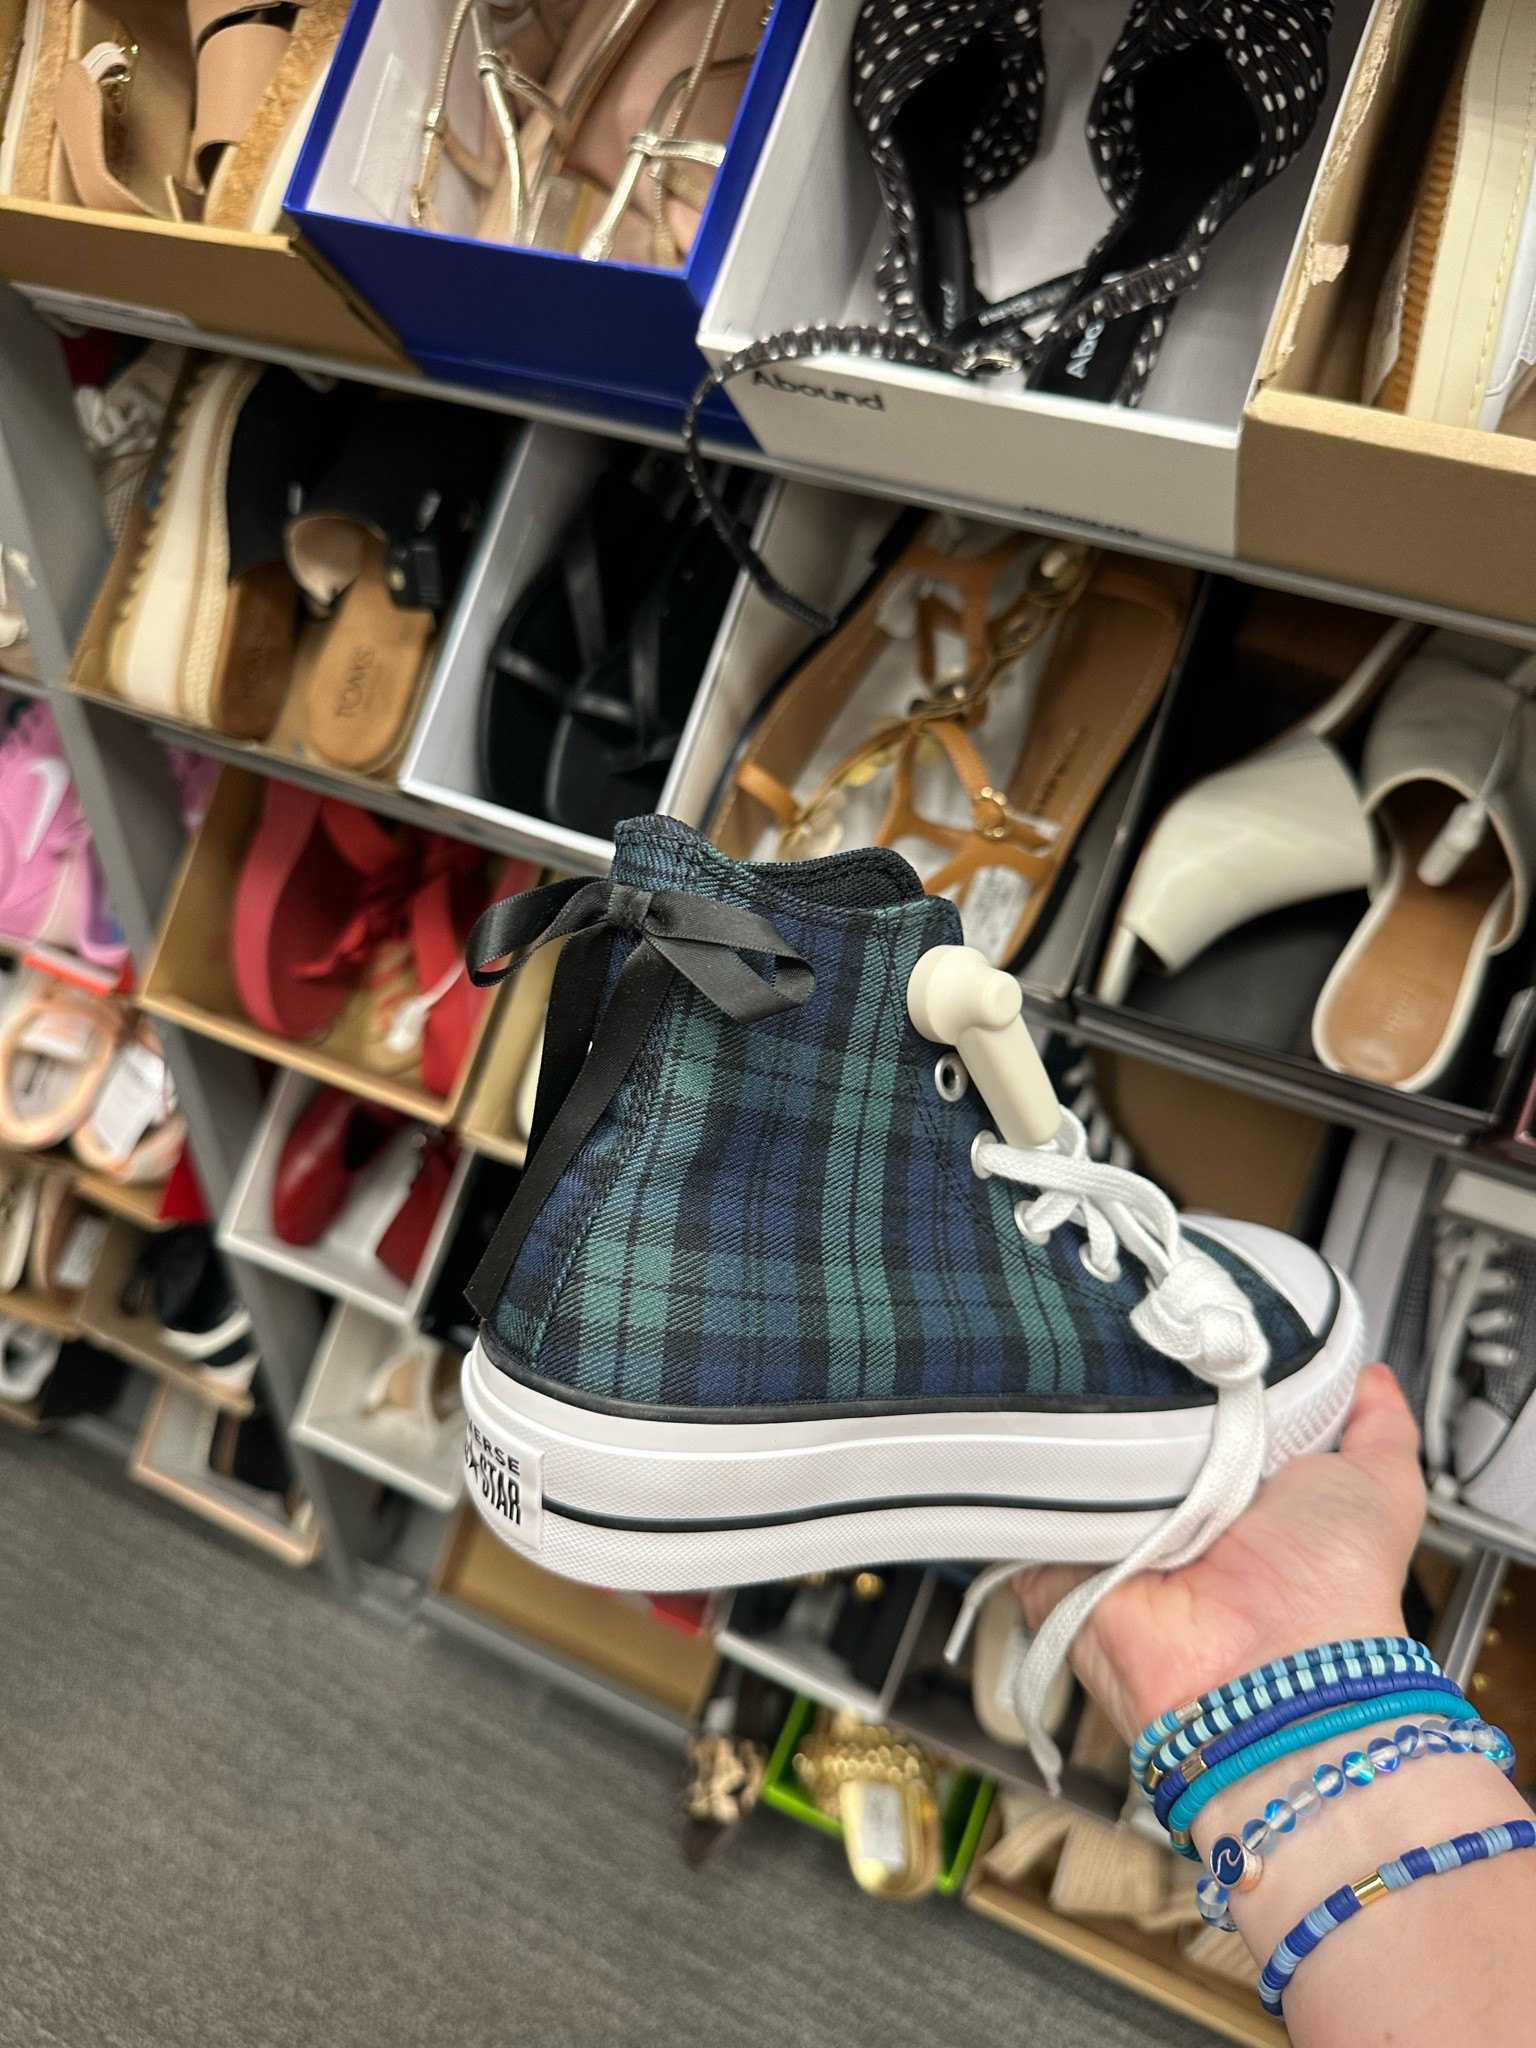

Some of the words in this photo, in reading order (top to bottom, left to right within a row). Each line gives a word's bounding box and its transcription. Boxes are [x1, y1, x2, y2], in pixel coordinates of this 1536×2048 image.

[1065, 318, 1106, 379] Abo
[753, 370, 885, 411] Abound
[480, 1452, 521, 1525] STAR
